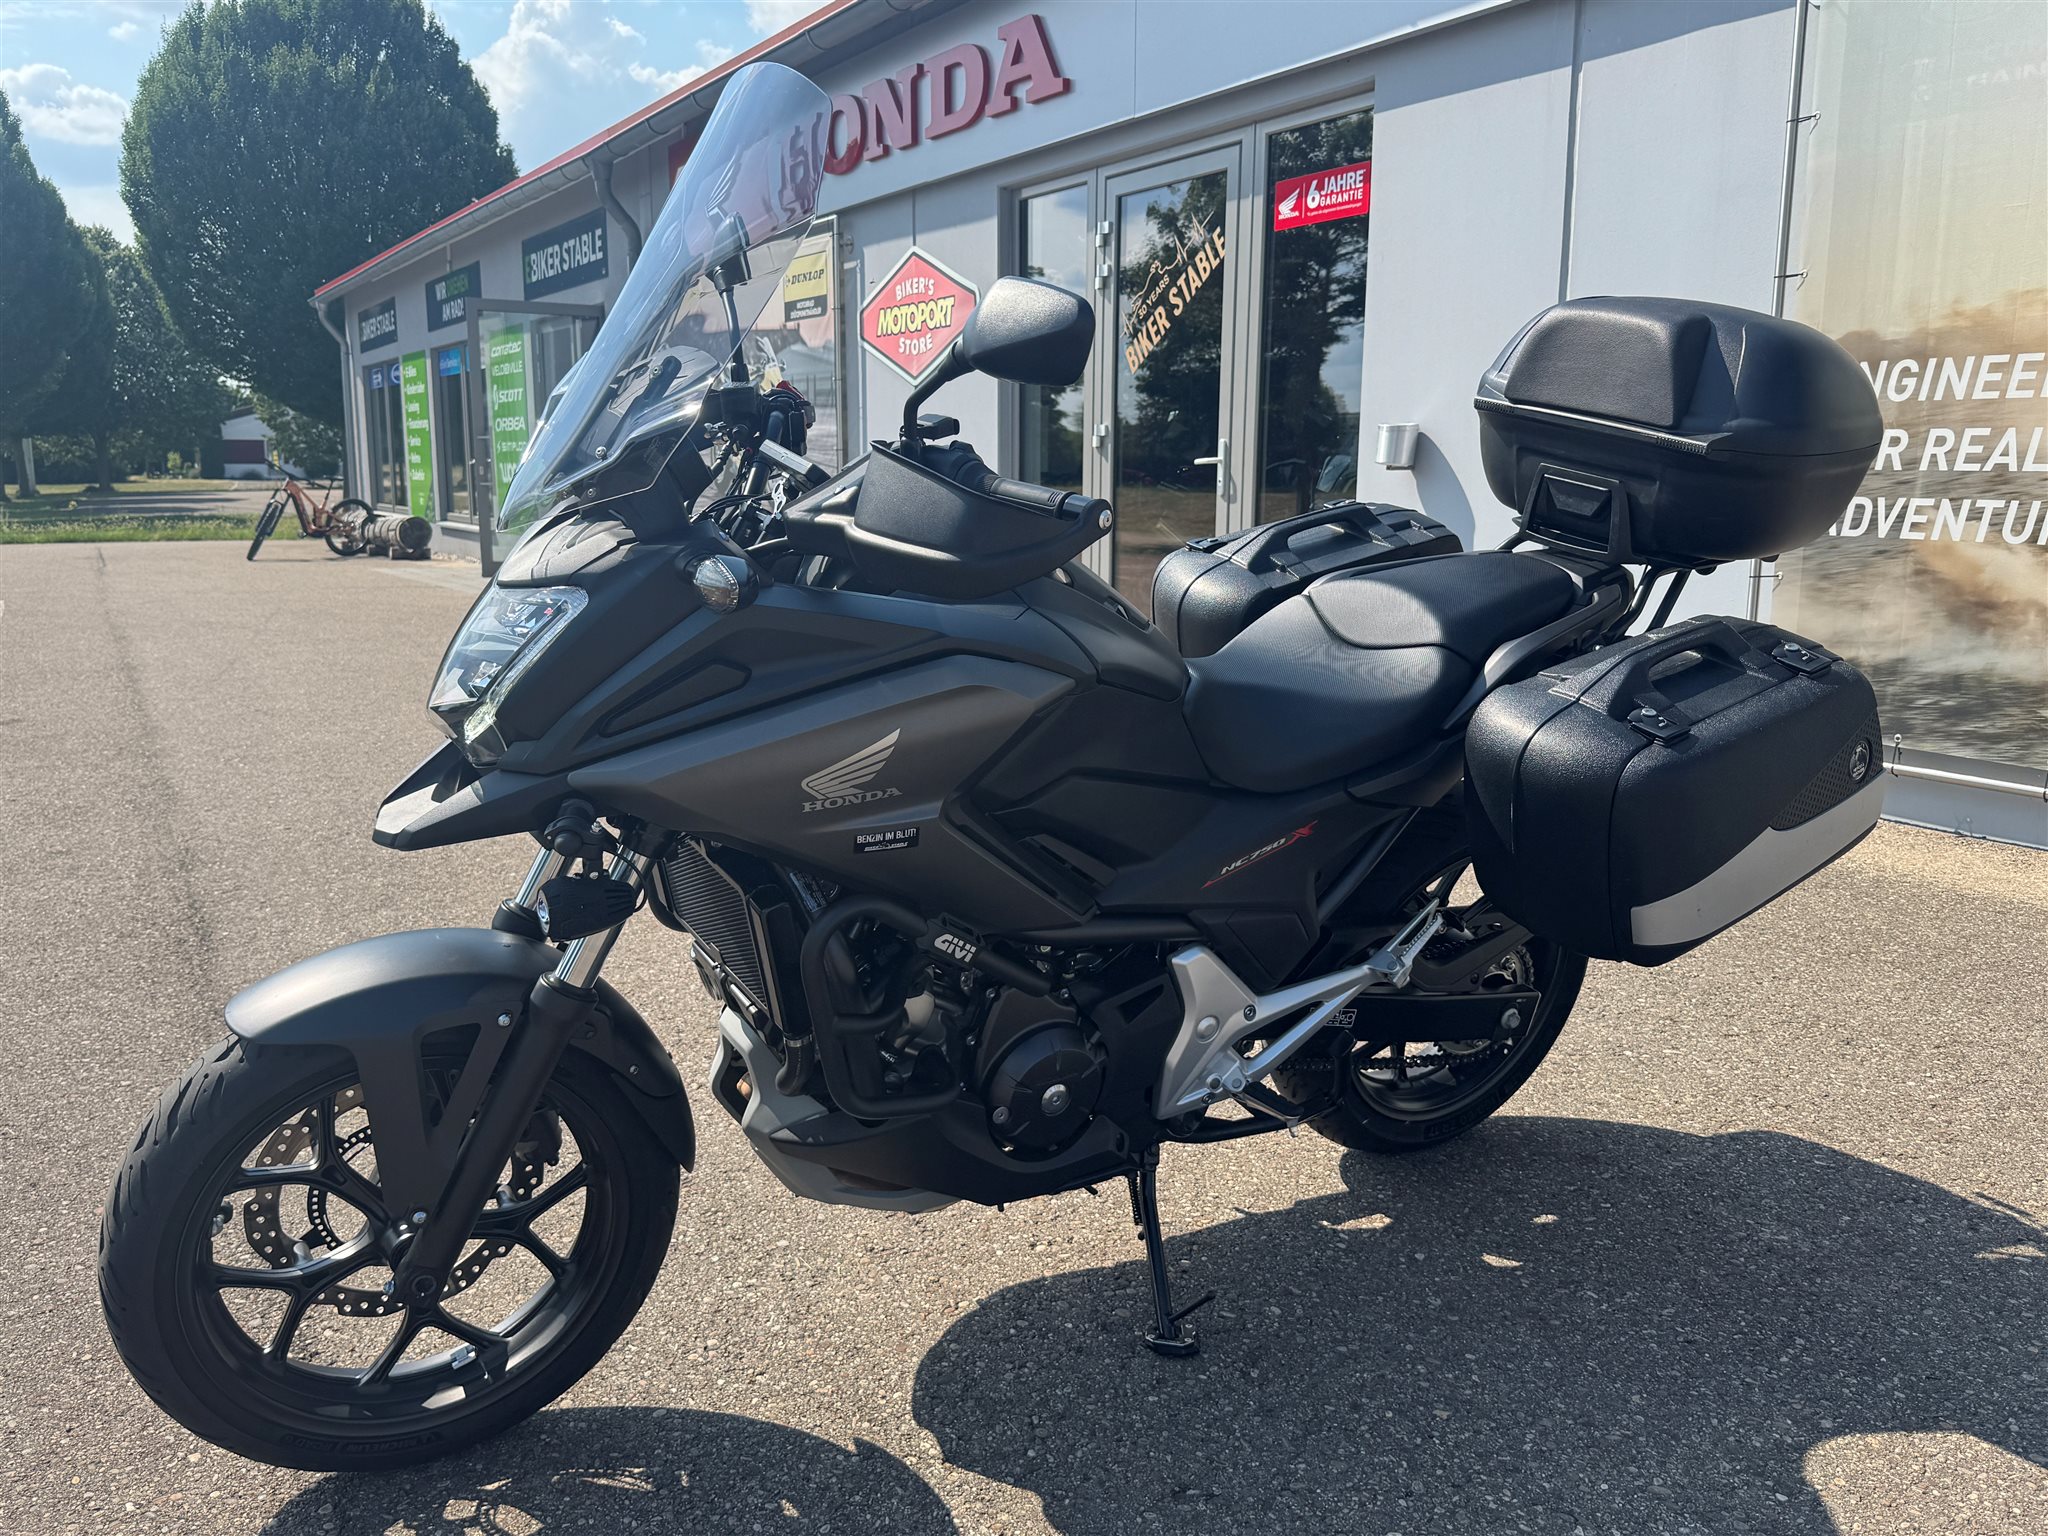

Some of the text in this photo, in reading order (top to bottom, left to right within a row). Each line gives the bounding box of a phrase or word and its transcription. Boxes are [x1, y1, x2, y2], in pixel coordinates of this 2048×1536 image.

[1306, 179, 1320, 209] 6
[1320, 188, 1363, 207] GARANTIE
[562, 227, 603, 271] STABLE
[791, 268, 825, 285] DUNLOP
[895, 277, 935, 301] BIKER'S
[1125, 226, 1226, 375] BIKER STABLE
[1137, 274, 1169, 319] 30 YEARS
[876, 295, 955, 337] MOTOPORT
[898, 332, 933, 355] STORE
[1858, 352, 2048, 402] NGINEE
[498, 388, 524, 403] SCOTT
[495, 416, 526, 432] ORBEA
[1829, 496, 2048, 545] DVENTU
[802, 787, 903, 813] HONDA
[856, 833, 883, 844] BENZIN
[885, 831, 894, 841] IM
[934, 933, 977, 963] GIVI
